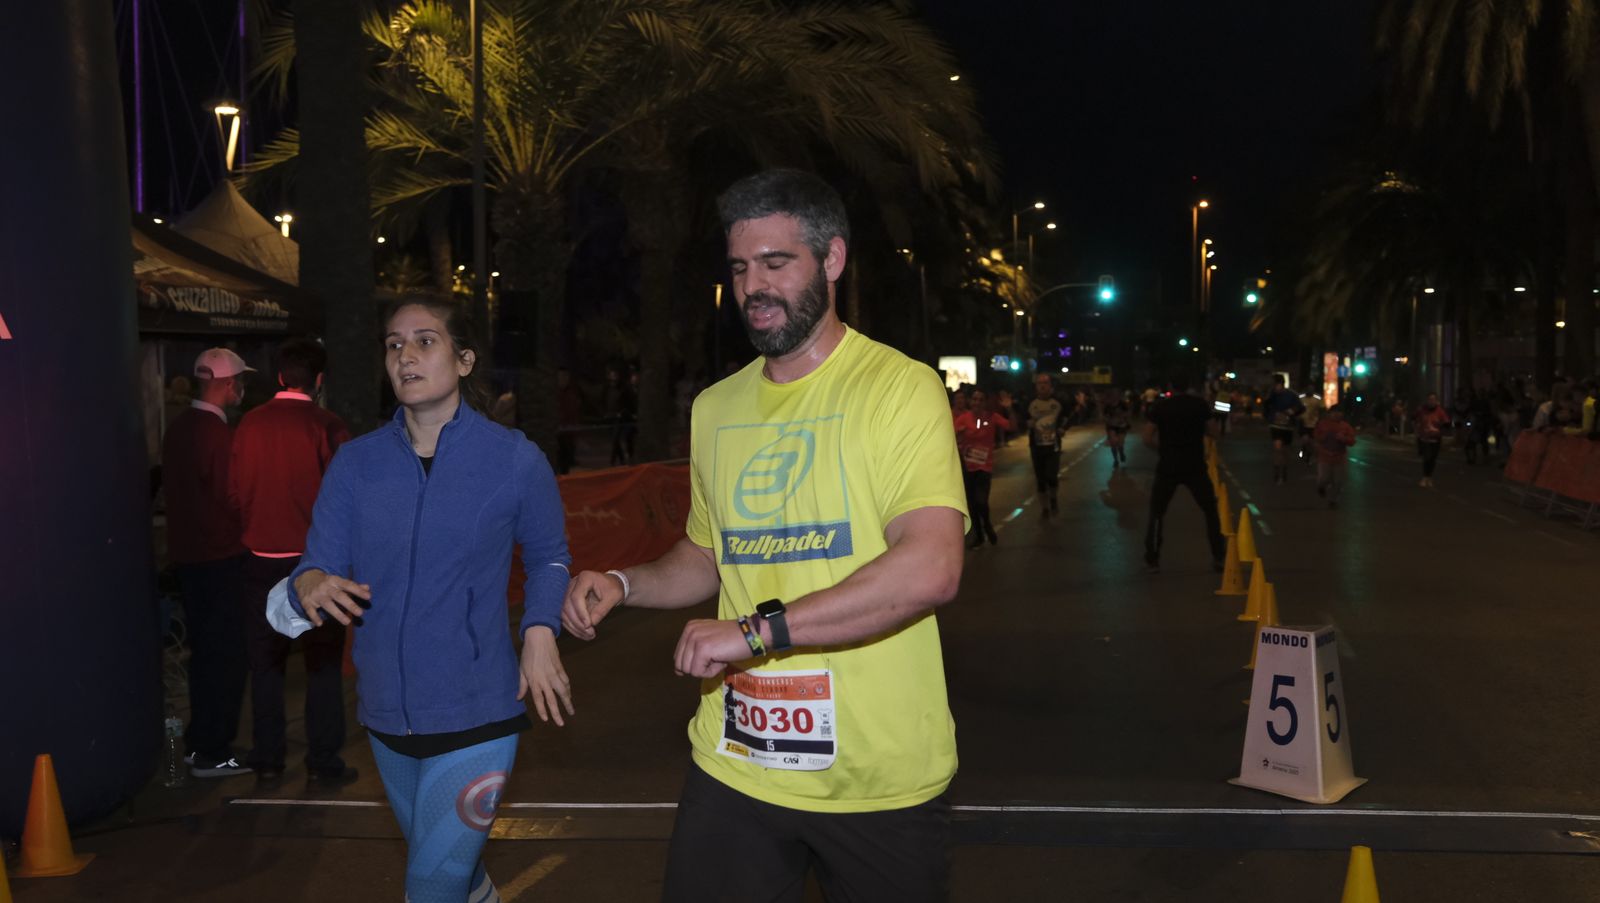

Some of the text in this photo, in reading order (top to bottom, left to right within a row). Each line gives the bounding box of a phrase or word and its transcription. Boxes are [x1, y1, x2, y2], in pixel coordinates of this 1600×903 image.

[727, 529, 836, 560] Bullpadel
[1261, 632, 1309, 648] MONDO
[735, 699, 814, 734] 3030
[1266, 674, 1298, 746] 5
[1324, 671, 1341, 744] 5
[766, 740, 775, 752] 15
